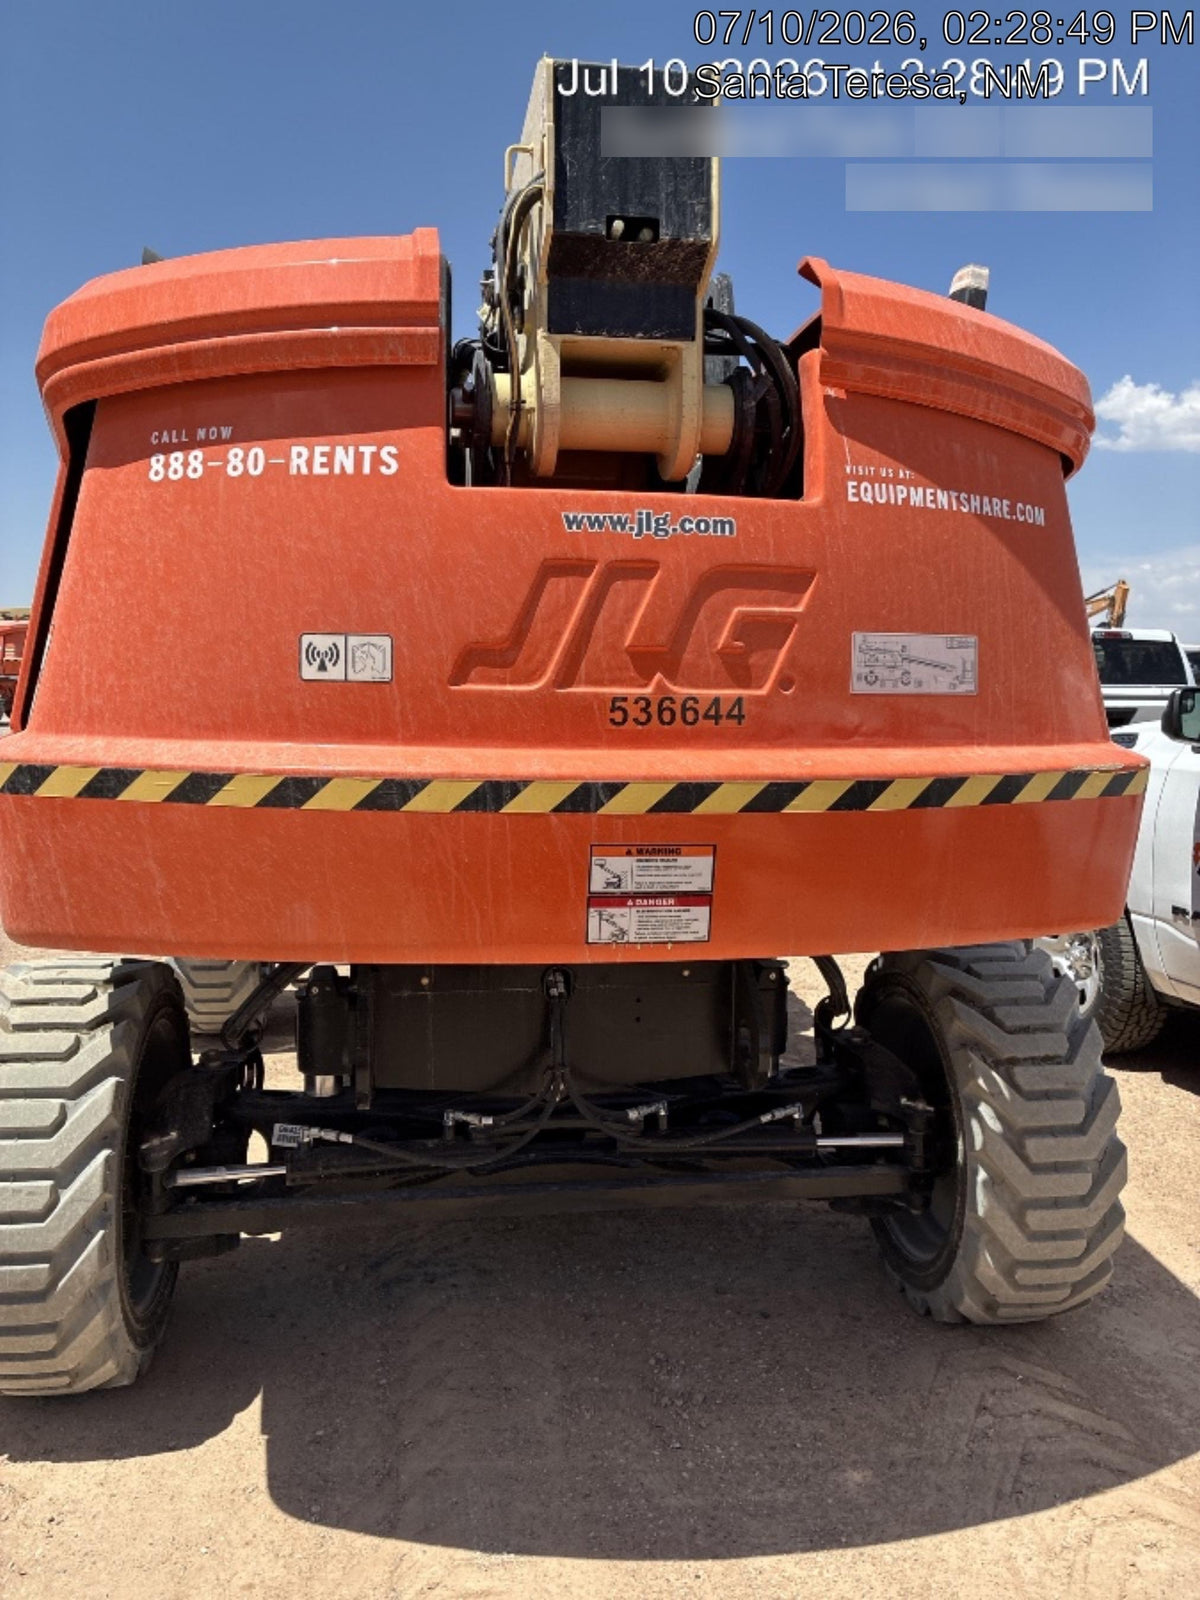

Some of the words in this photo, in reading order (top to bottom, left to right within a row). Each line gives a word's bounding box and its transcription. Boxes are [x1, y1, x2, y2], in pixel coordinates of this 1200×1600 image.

[151, 429, 189, 445] CALL
[197, 426, 233, 441] NOW
[148, 445, 400, 482] 888-80-RENTS
[845, 465, 875, 476] VISIT
[880, 467, 894, 478] US
[847, 481, 1046, 527] EQUIPMENTSHARE.COM
[562, 511, 737, 539] www.jlg.com
[447, 557, 819, 696] JLG
[608, 696, 746, 727] 536644
[636, 847, 682, 856] WARNING
[635, 898, 675, 906] DANGER
